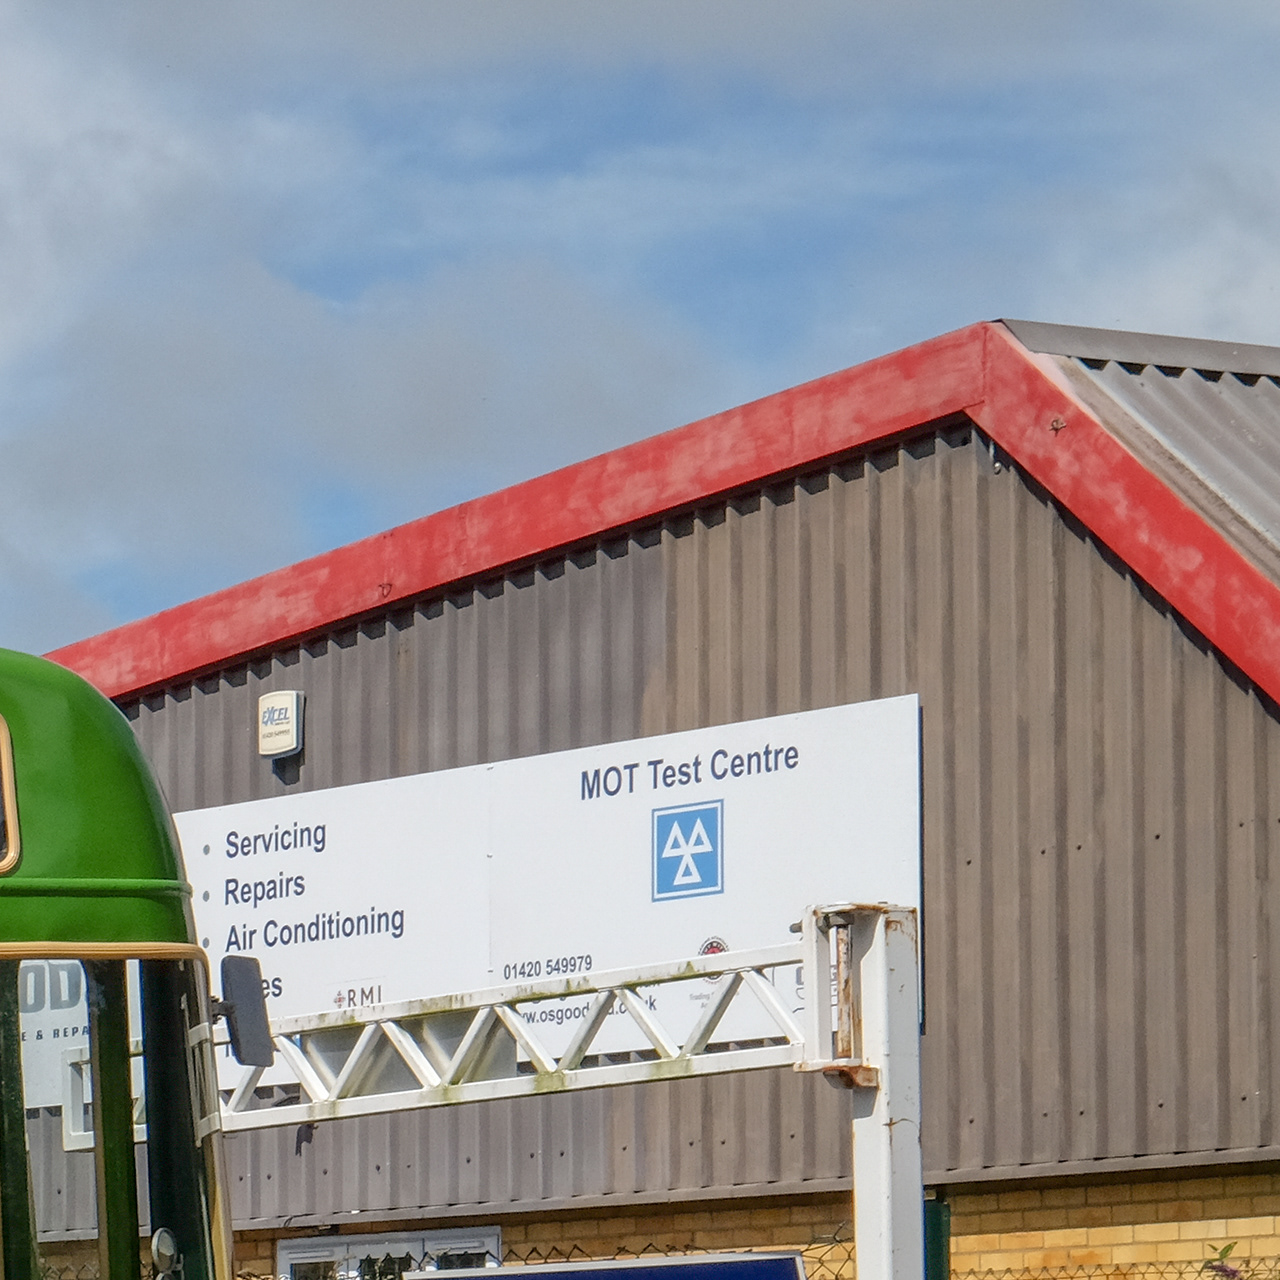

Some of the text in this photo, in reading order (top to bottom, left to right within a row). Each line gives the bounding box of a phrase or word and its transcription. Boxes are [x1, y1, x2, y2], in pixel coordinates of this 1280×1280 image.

[581, 744, 798, 800] MOT Test Centre
[226, 822, 326, 858] Servicing
[225, 872, 305, 908] Repairs
[225, 906, 404, 952] Air Conditioning
[504, 954, 592, 979] 01420 549979
[347, 984, 383, 1007] RMI
[36, 1030, 43, 1040] &
